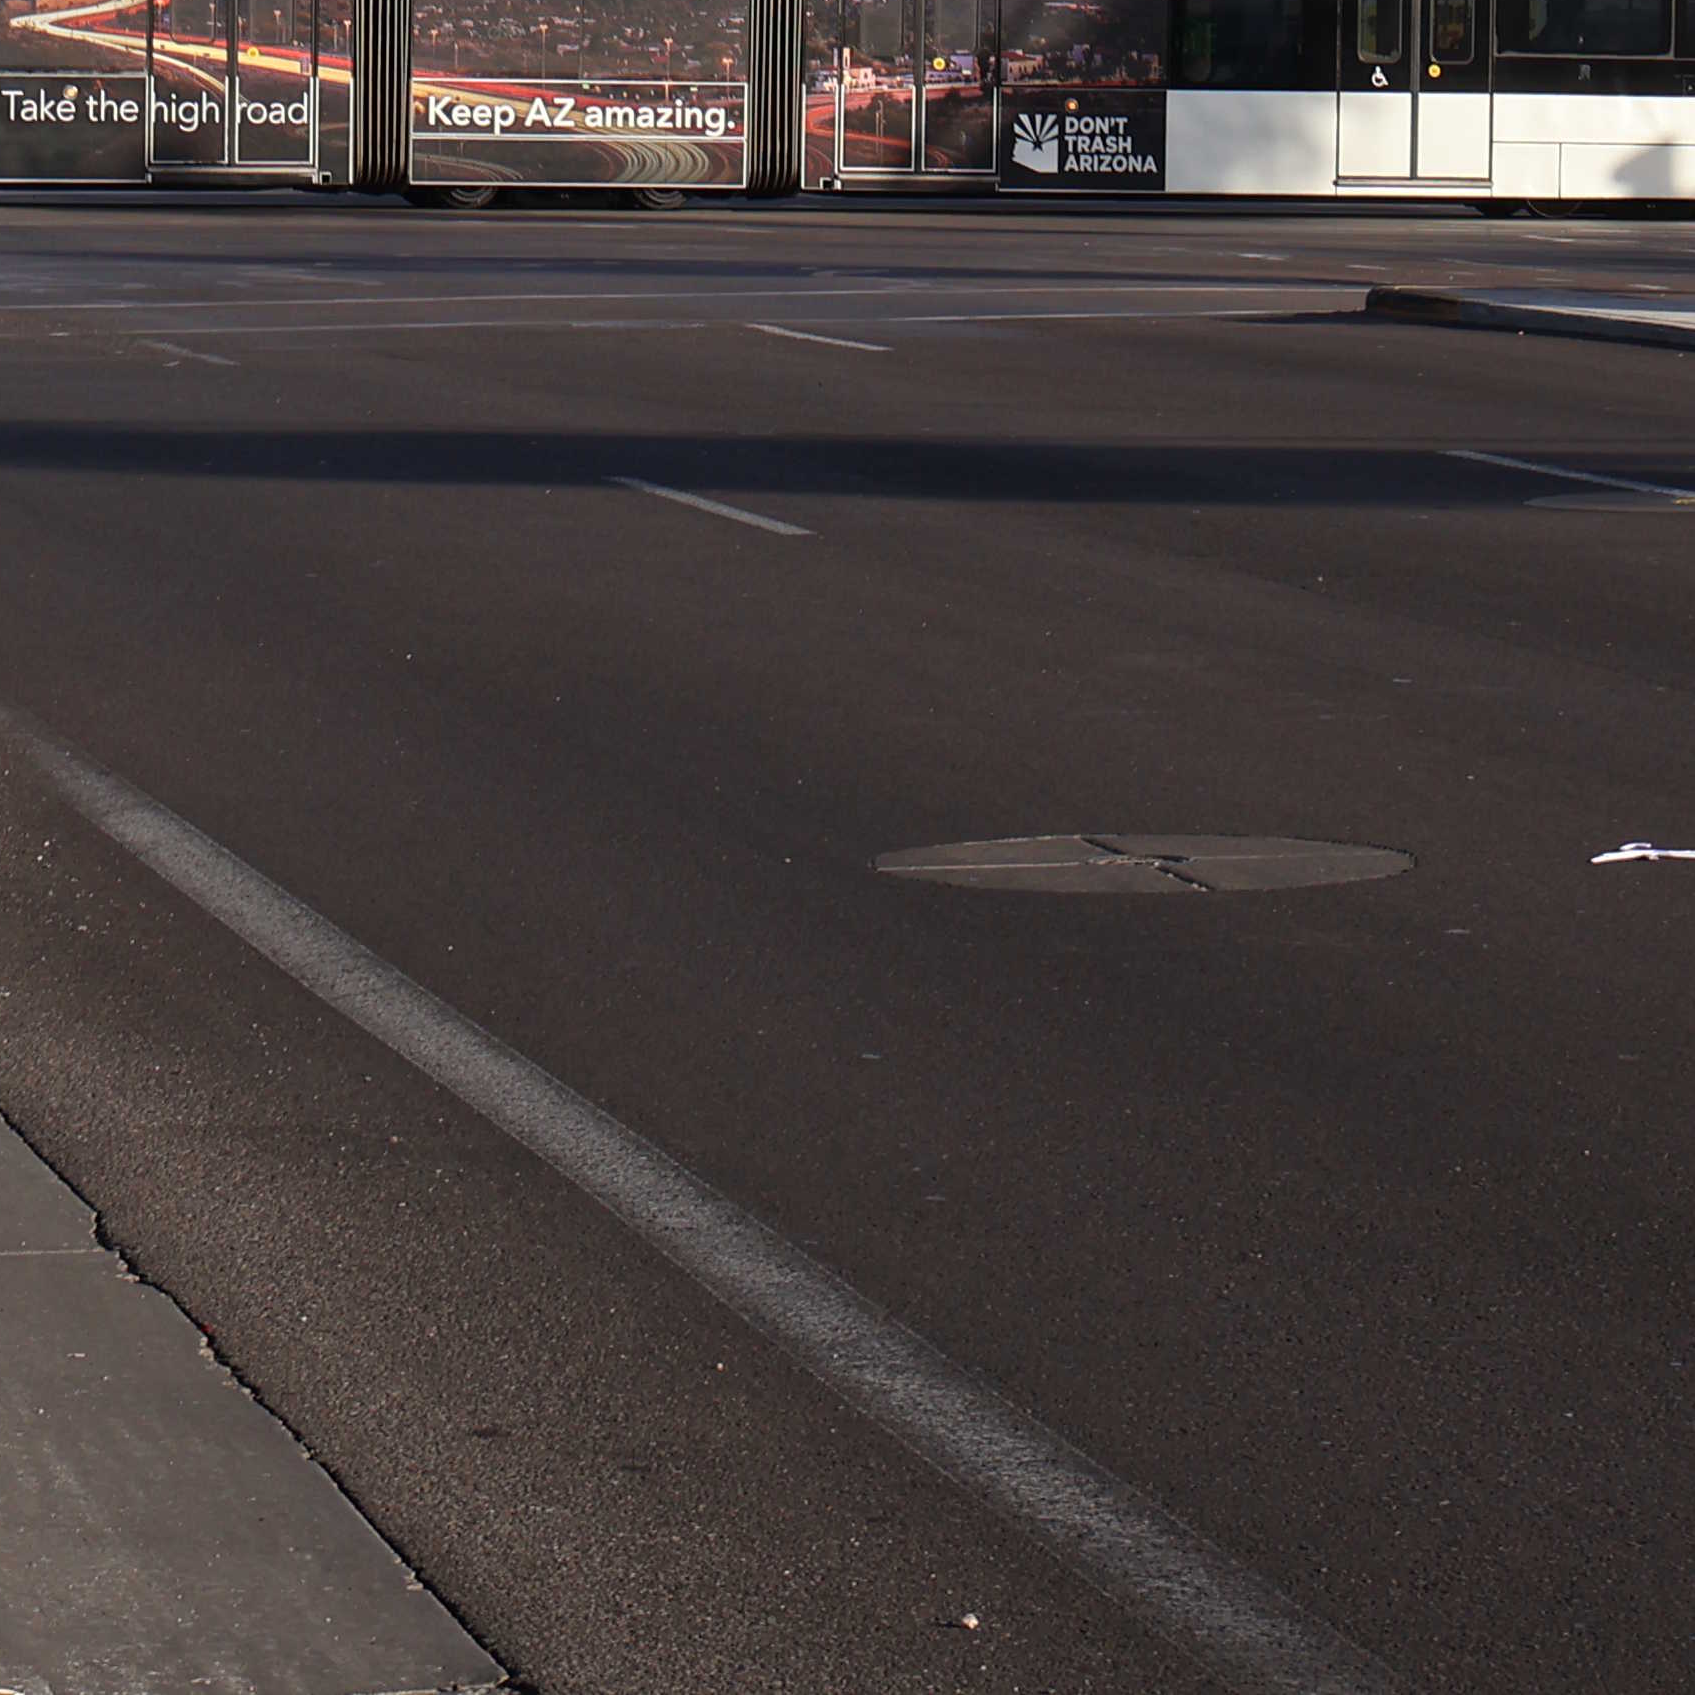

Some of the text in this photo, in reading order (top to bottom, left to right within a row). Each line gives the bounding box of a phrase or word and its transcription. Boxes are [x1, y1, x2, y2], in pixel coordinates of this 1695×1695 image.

[0, 89, 310, 133] Take the high road
[427, 96, 736, 137] Keep AZ amazing.
[1064, 116, 1129, 135] DON'T
[1064, 135, 1133, 154] TRASH
[1063, 154, 1158, 174] ARIZONA
